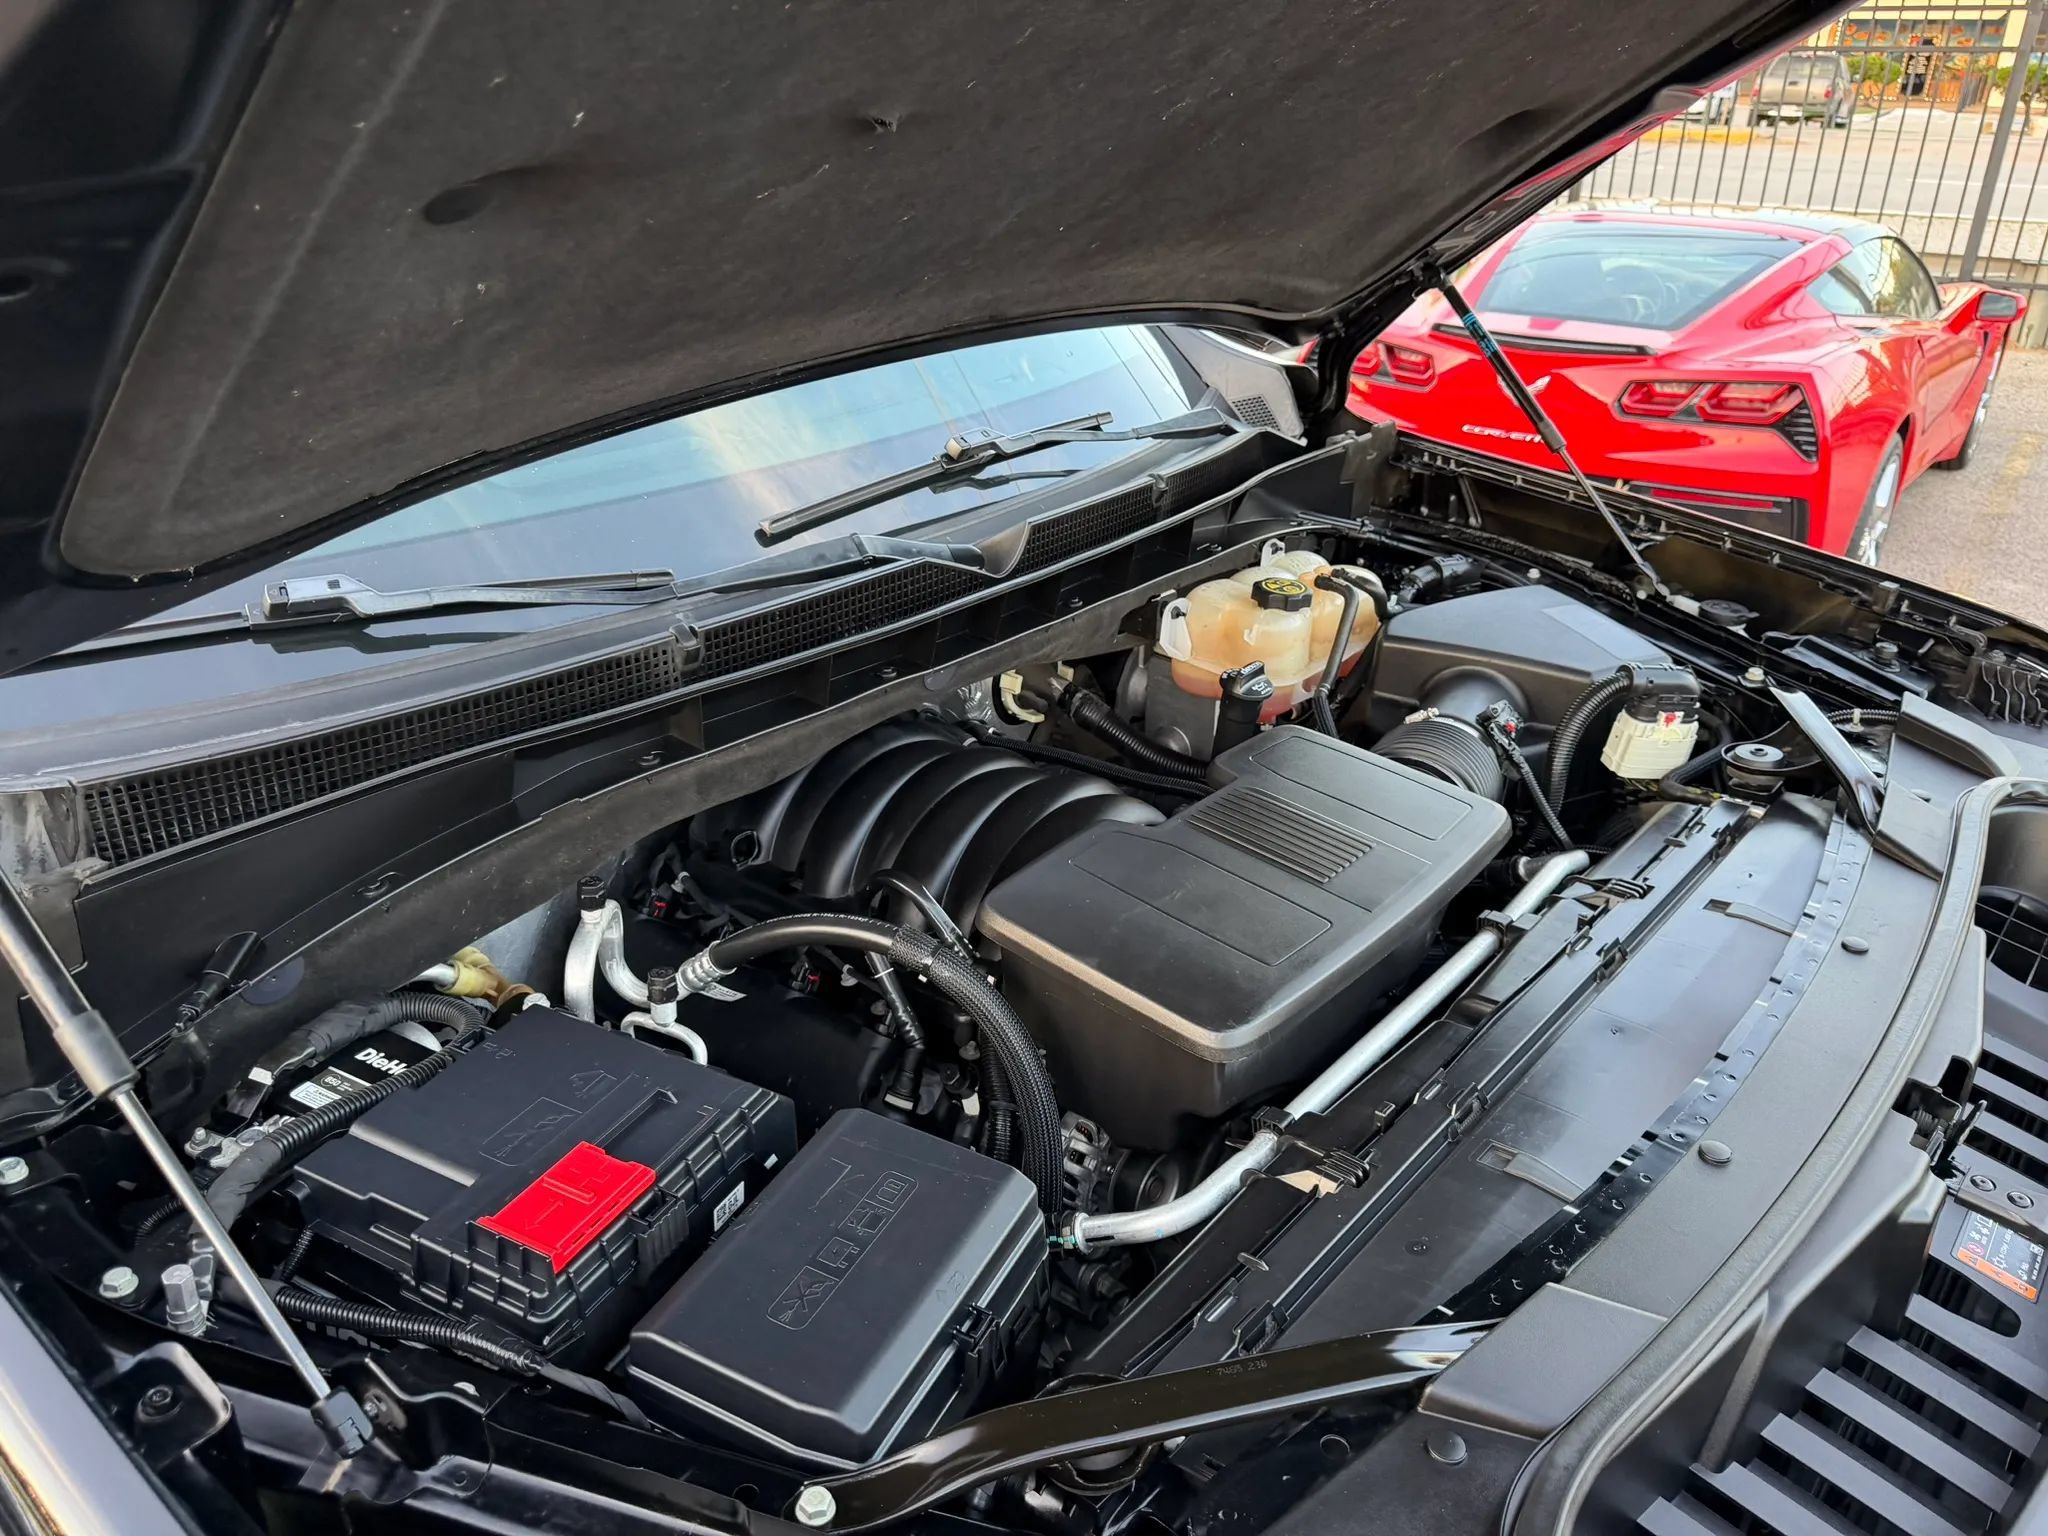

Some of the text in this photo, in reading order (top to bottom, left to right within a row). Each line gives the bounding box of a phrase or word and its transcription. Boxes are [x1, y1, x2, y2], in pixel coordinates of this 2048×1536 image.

[1462, 424, 1545, 444] CORVETT
[354, 1047, 408, 1076] DieH
[324, 1076, 342, 1087] 850
